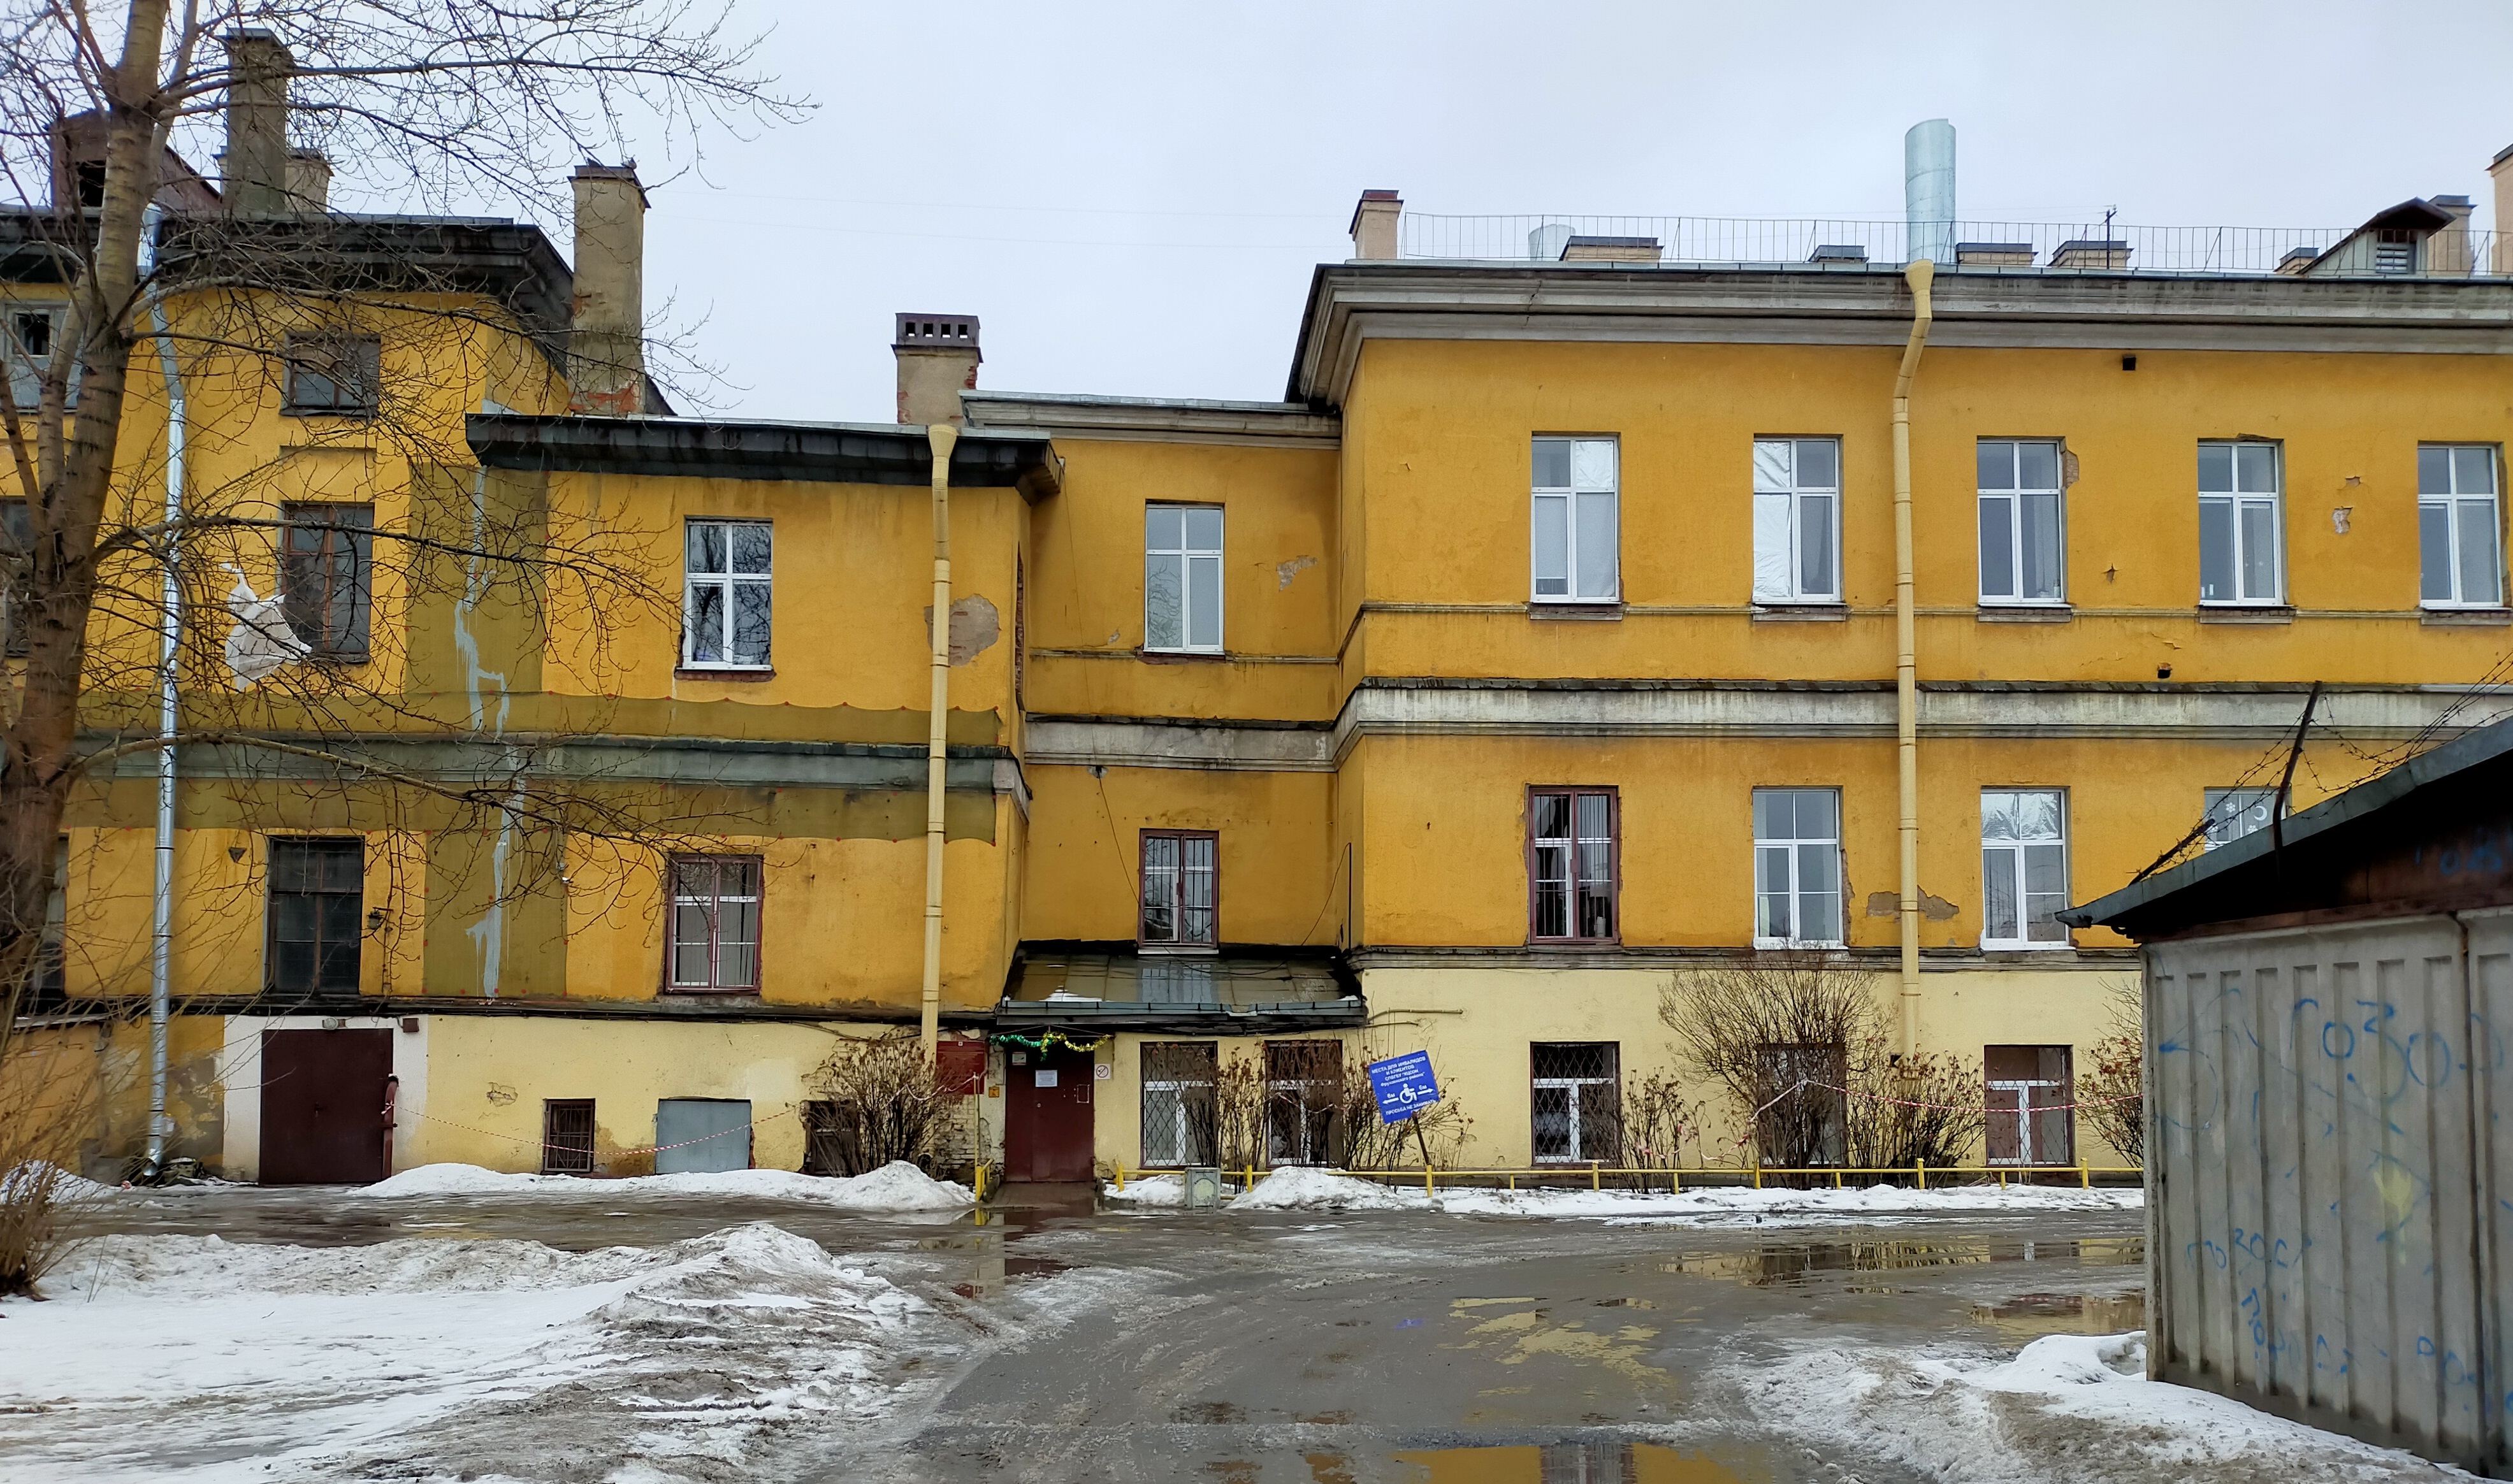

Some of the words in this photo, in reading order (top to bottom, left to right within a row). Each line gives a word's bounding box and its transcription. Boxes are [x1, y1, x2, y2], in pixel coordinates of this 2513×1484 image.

[1398, 1056, 1426, 1067] ИНВАЛИДОВ
[1390, 1065, 1415, 1074] КЛИЕНТОВ
[1380, 1077, 1409, 1086] Фрунзенского
[1386, 1106, 1407, 1115] ПРОСЬБА
[1413, 1099, 1437, 1107] ЗАНИМАТЬ
